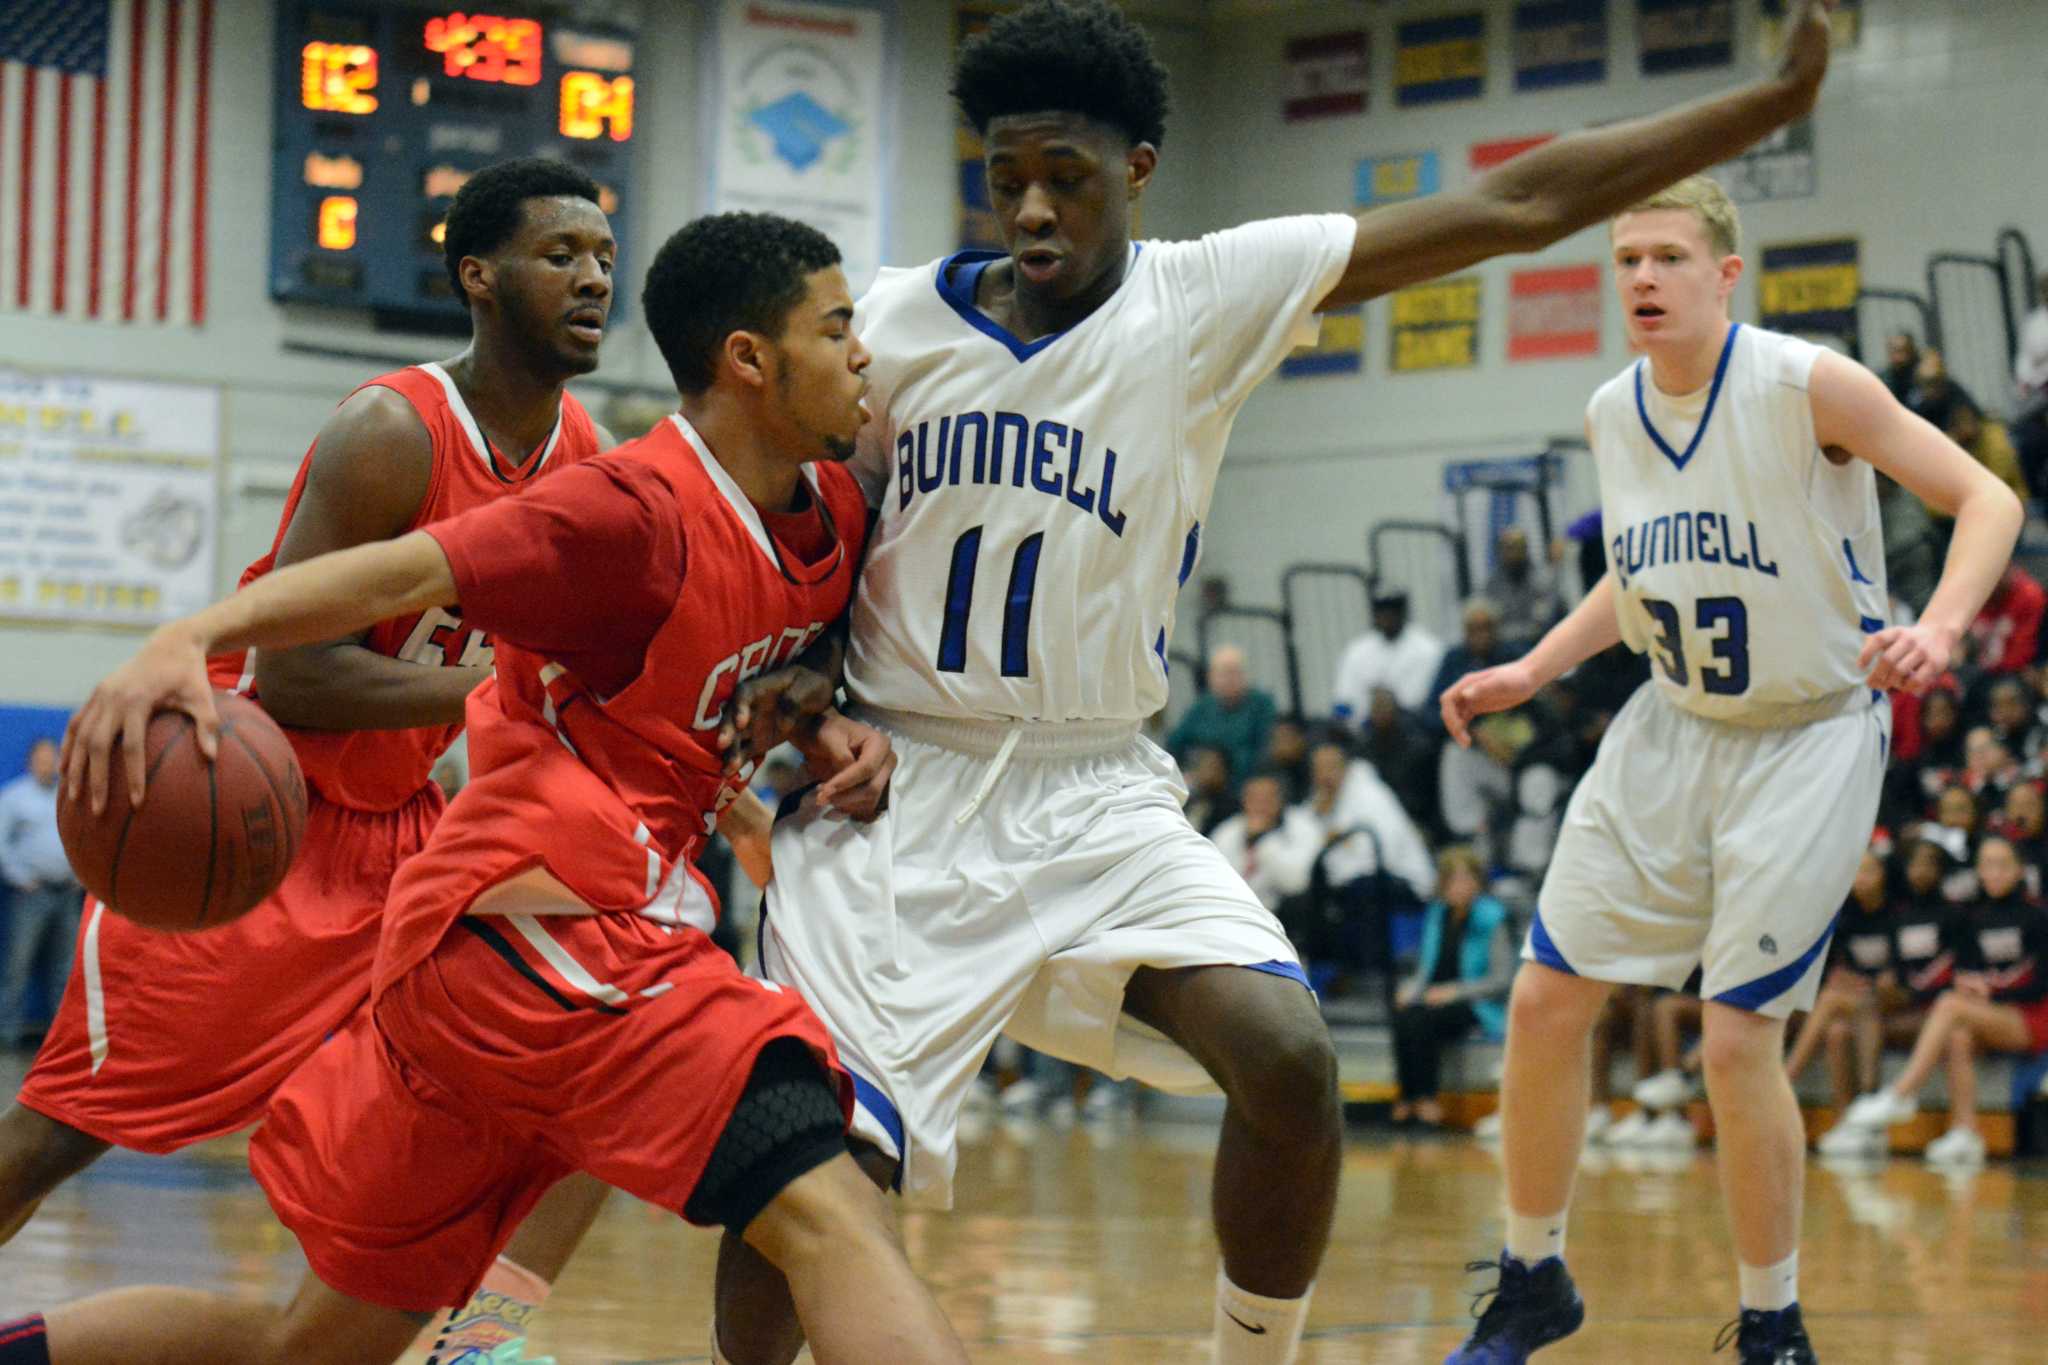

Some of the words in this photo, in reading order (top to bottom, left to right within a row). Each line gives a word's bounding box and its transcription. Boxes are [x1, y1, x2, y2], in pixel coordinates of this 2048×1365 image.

[897, 410, 1127, 538] BUNNELL
[936, 525, 1045, 677] 11
[1640, 596, 1750, 695] 33
